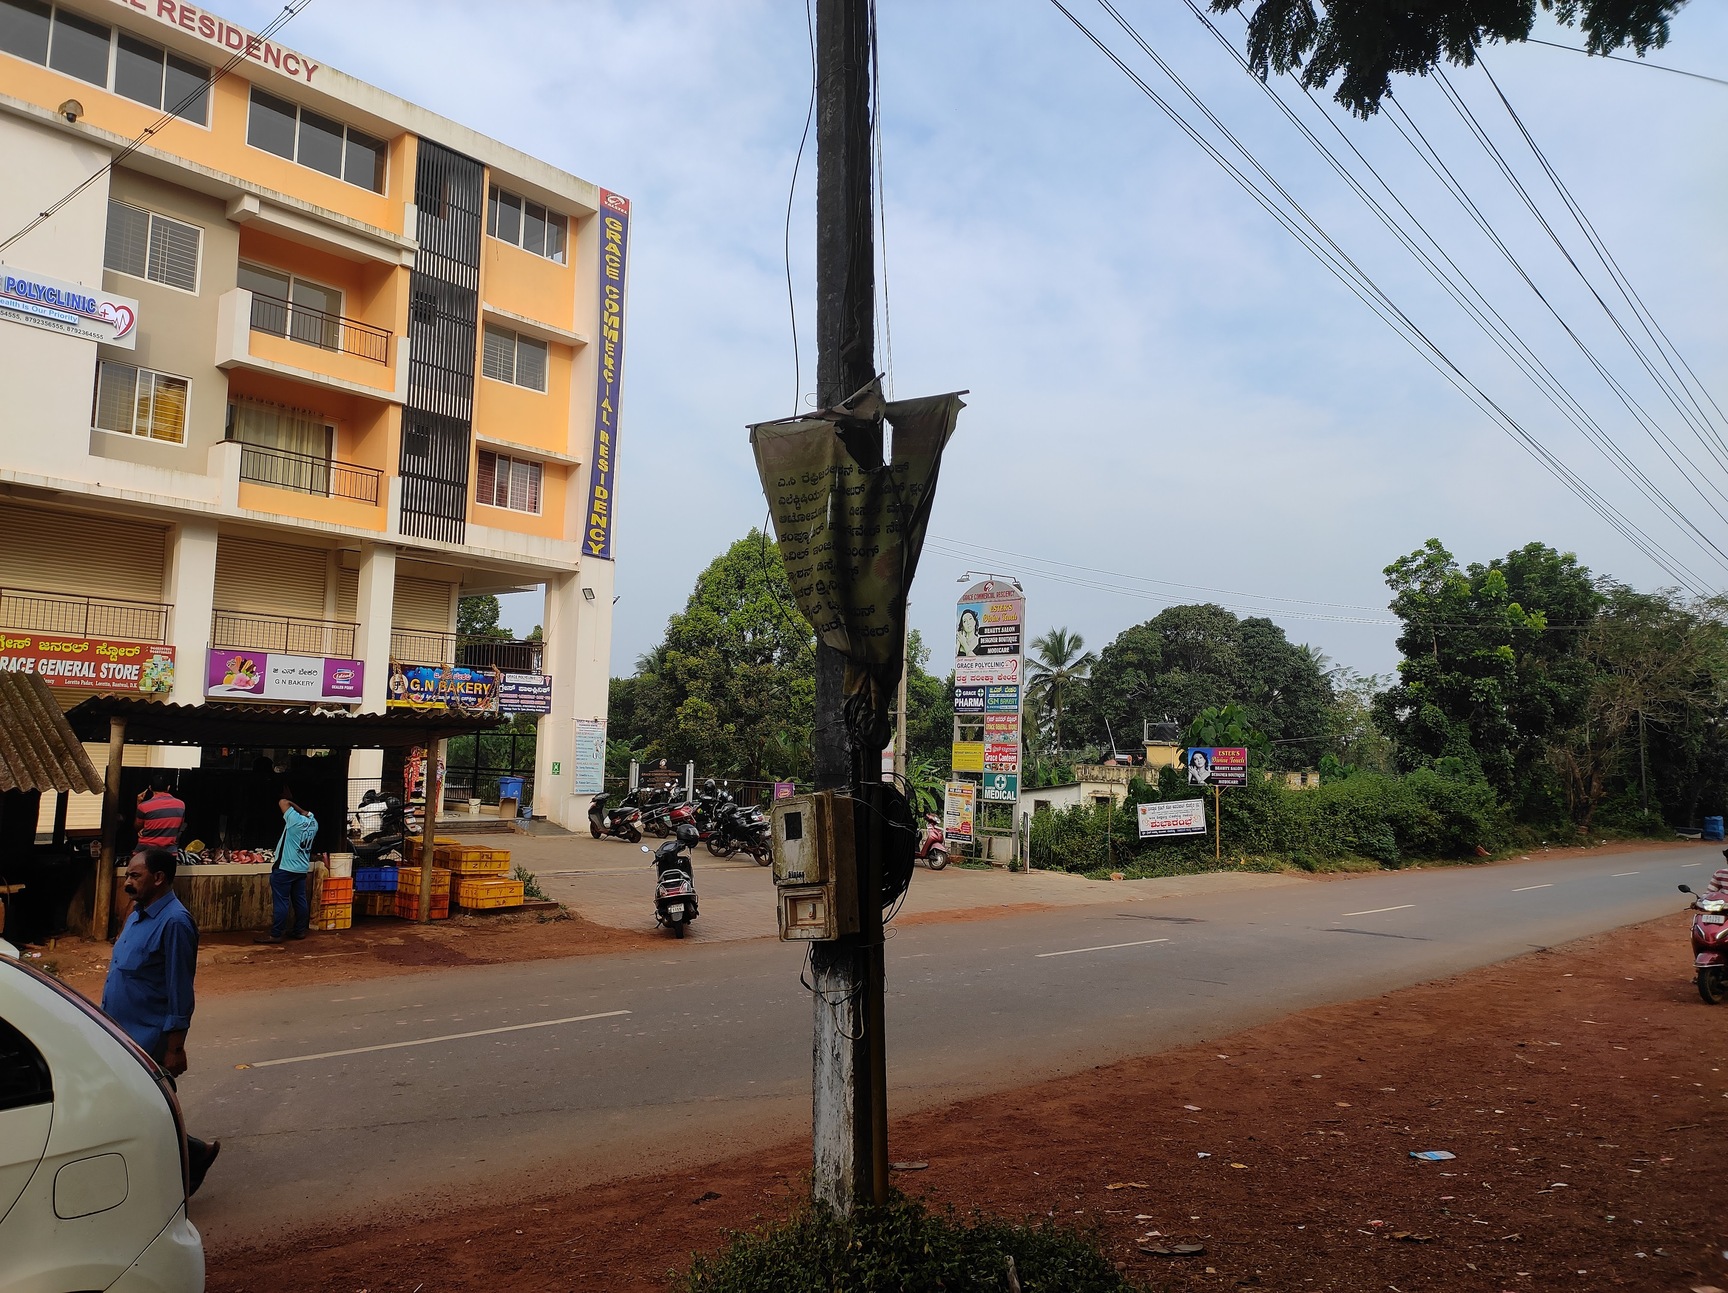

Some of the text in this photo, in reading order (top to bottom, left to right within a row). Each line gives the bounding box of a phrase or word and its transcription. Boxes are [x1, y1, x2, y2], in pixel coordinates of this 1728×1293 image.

[157, 0, 318, 82] RESIDENCY
[5, 276, 97, 313] POLYCLINIC
[32, 305, 46, 314] Our
[48, 309, 78, 323] Priority
[587, 216, 623, 555] GRACE COMMERCIAL RESIDENCY
[38, 641, 90, 653] ಜನರಲ್
[96, 642, 141, 662] ಸ್ಟೋರ್
[38, 658, 97, 678] GENERAL
[100, 662, 141, 681] STORE
[410, 678, 434, 692] G.N
[439, 680, 492, 695] BAKERY
[955, 698, 984, 707] PHARMA
[985, 753, 1017, 763] Grace Canteen
[985, 790, 1016, 801] MEDICAL
